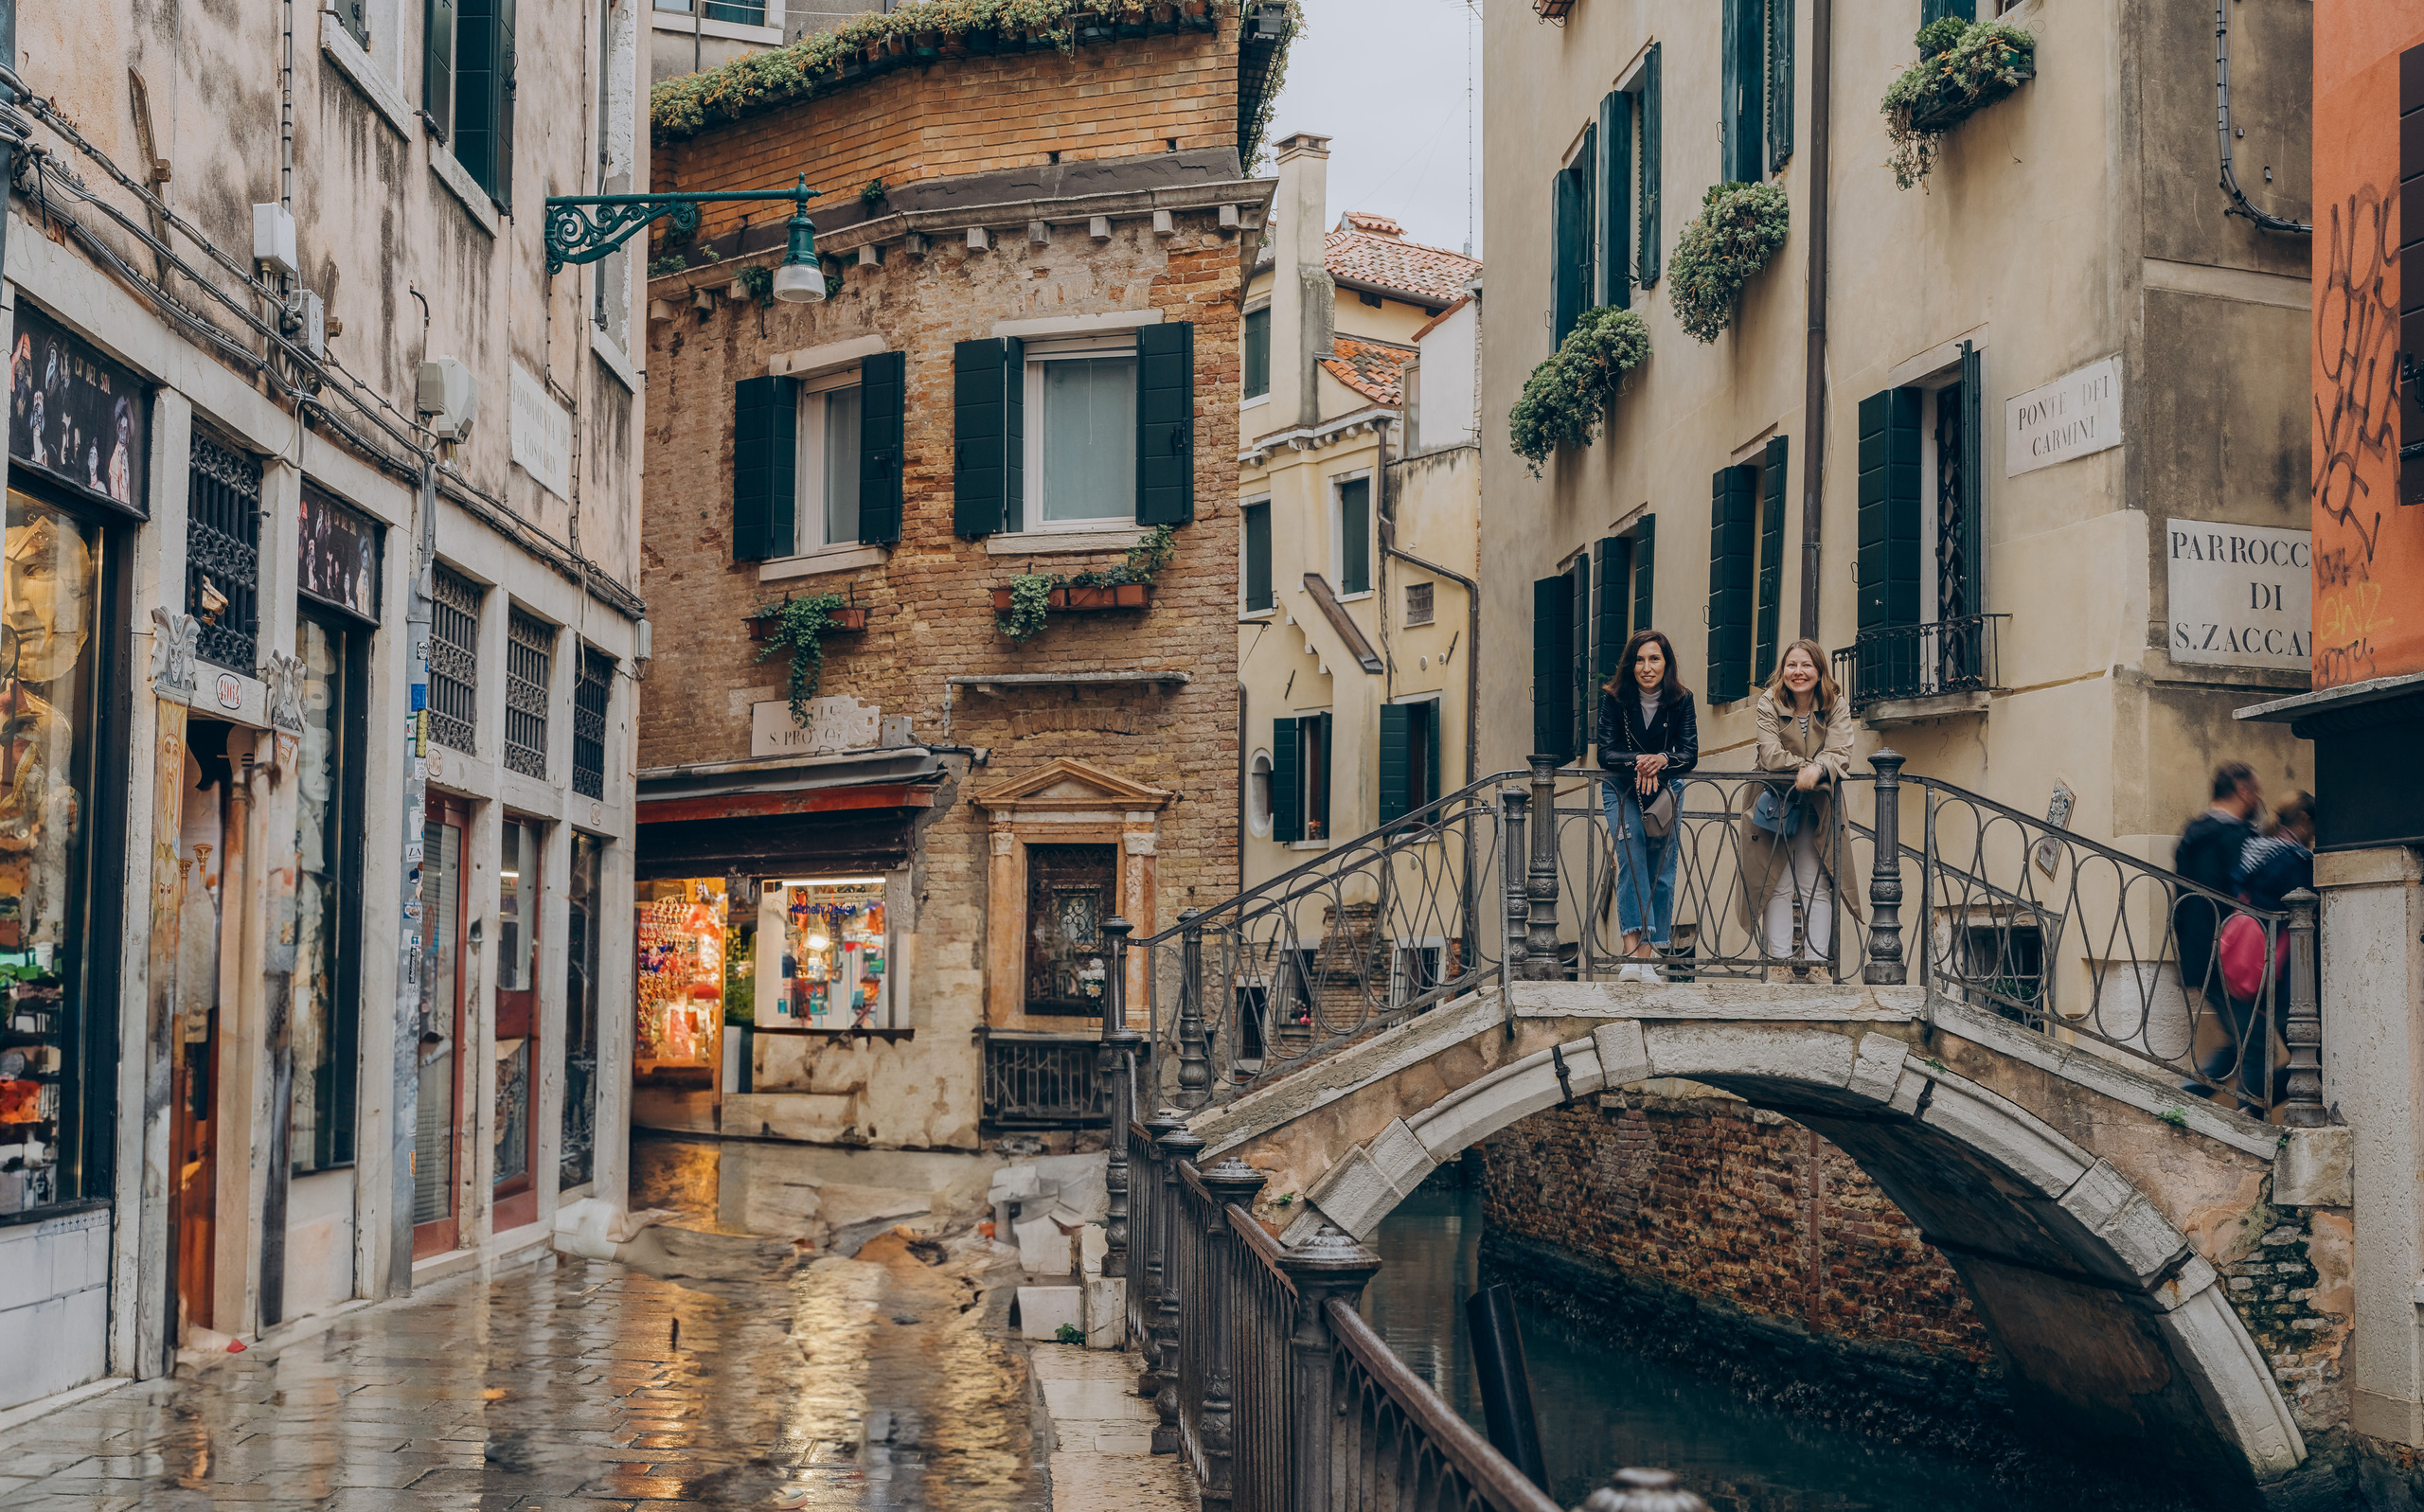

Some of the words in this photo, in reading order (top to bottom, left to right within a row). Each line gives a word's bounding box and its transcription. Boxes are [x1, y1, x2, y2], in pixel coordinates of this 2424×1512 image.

[86, 363, 97, 387] DEL
[100, 371, 111, 395] SOL
[2019, 391, 2066, 431] PONTE
[2082, 375, 2109, 406] DEI
[2032, 415, 2094, 456] CARMINI
[2170, 531, 2312, 568] PARROCC
[2250, 581, 2283, 612] DI
[218, 679, 241, 705] 4964
